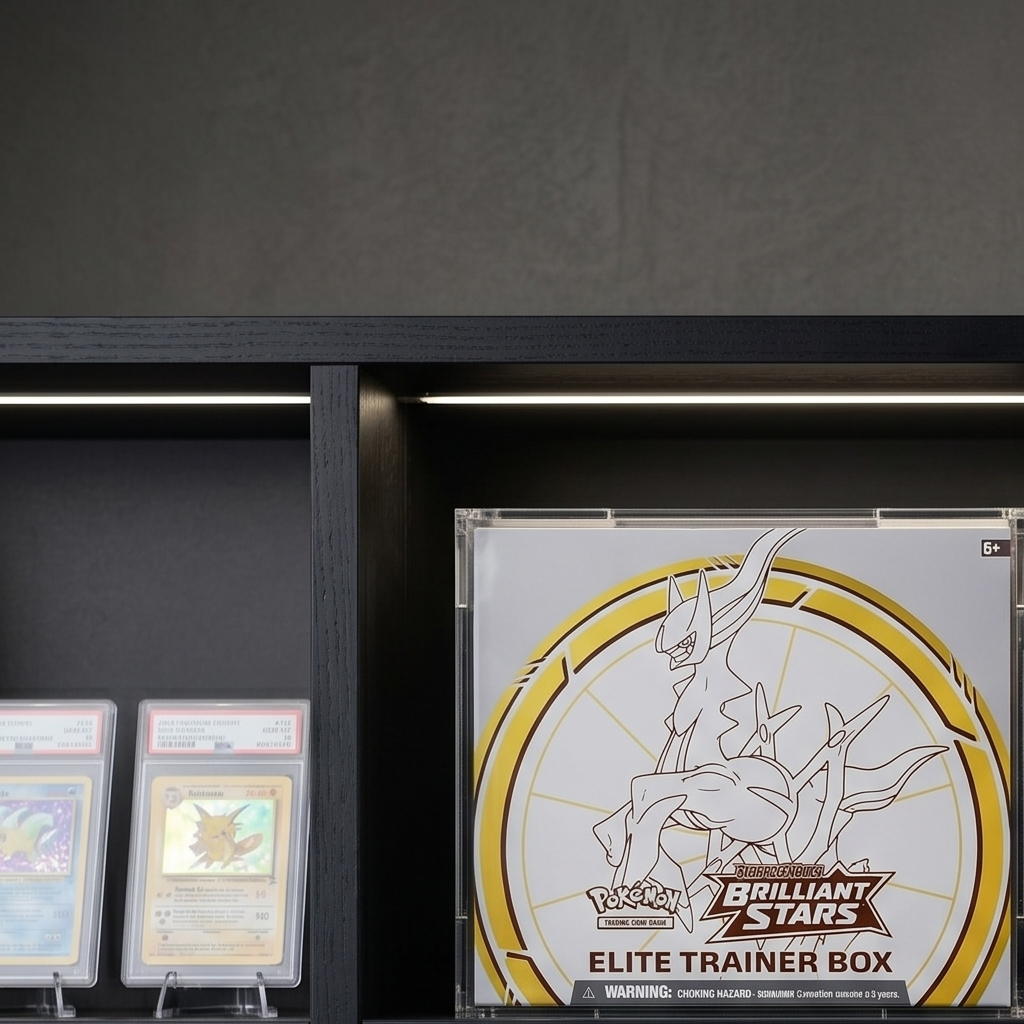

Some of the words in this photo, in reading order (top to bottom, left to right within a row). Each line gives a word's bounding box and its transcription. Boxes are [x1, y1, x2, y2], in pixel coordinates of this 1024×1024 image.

[983, 541, 1001, 555] 6+
[722, 881, 871, 907] BRILLIANT
[742, 902, 860, 930] STARS
[589, 950, 671, 973] ELITE
[680, 950, 818, 973] TRAINER
[828, 950, 893, 973] BOX
[604, 984, 672, 999] WARNING:
[677, 989, 715, 999] CHOKING
